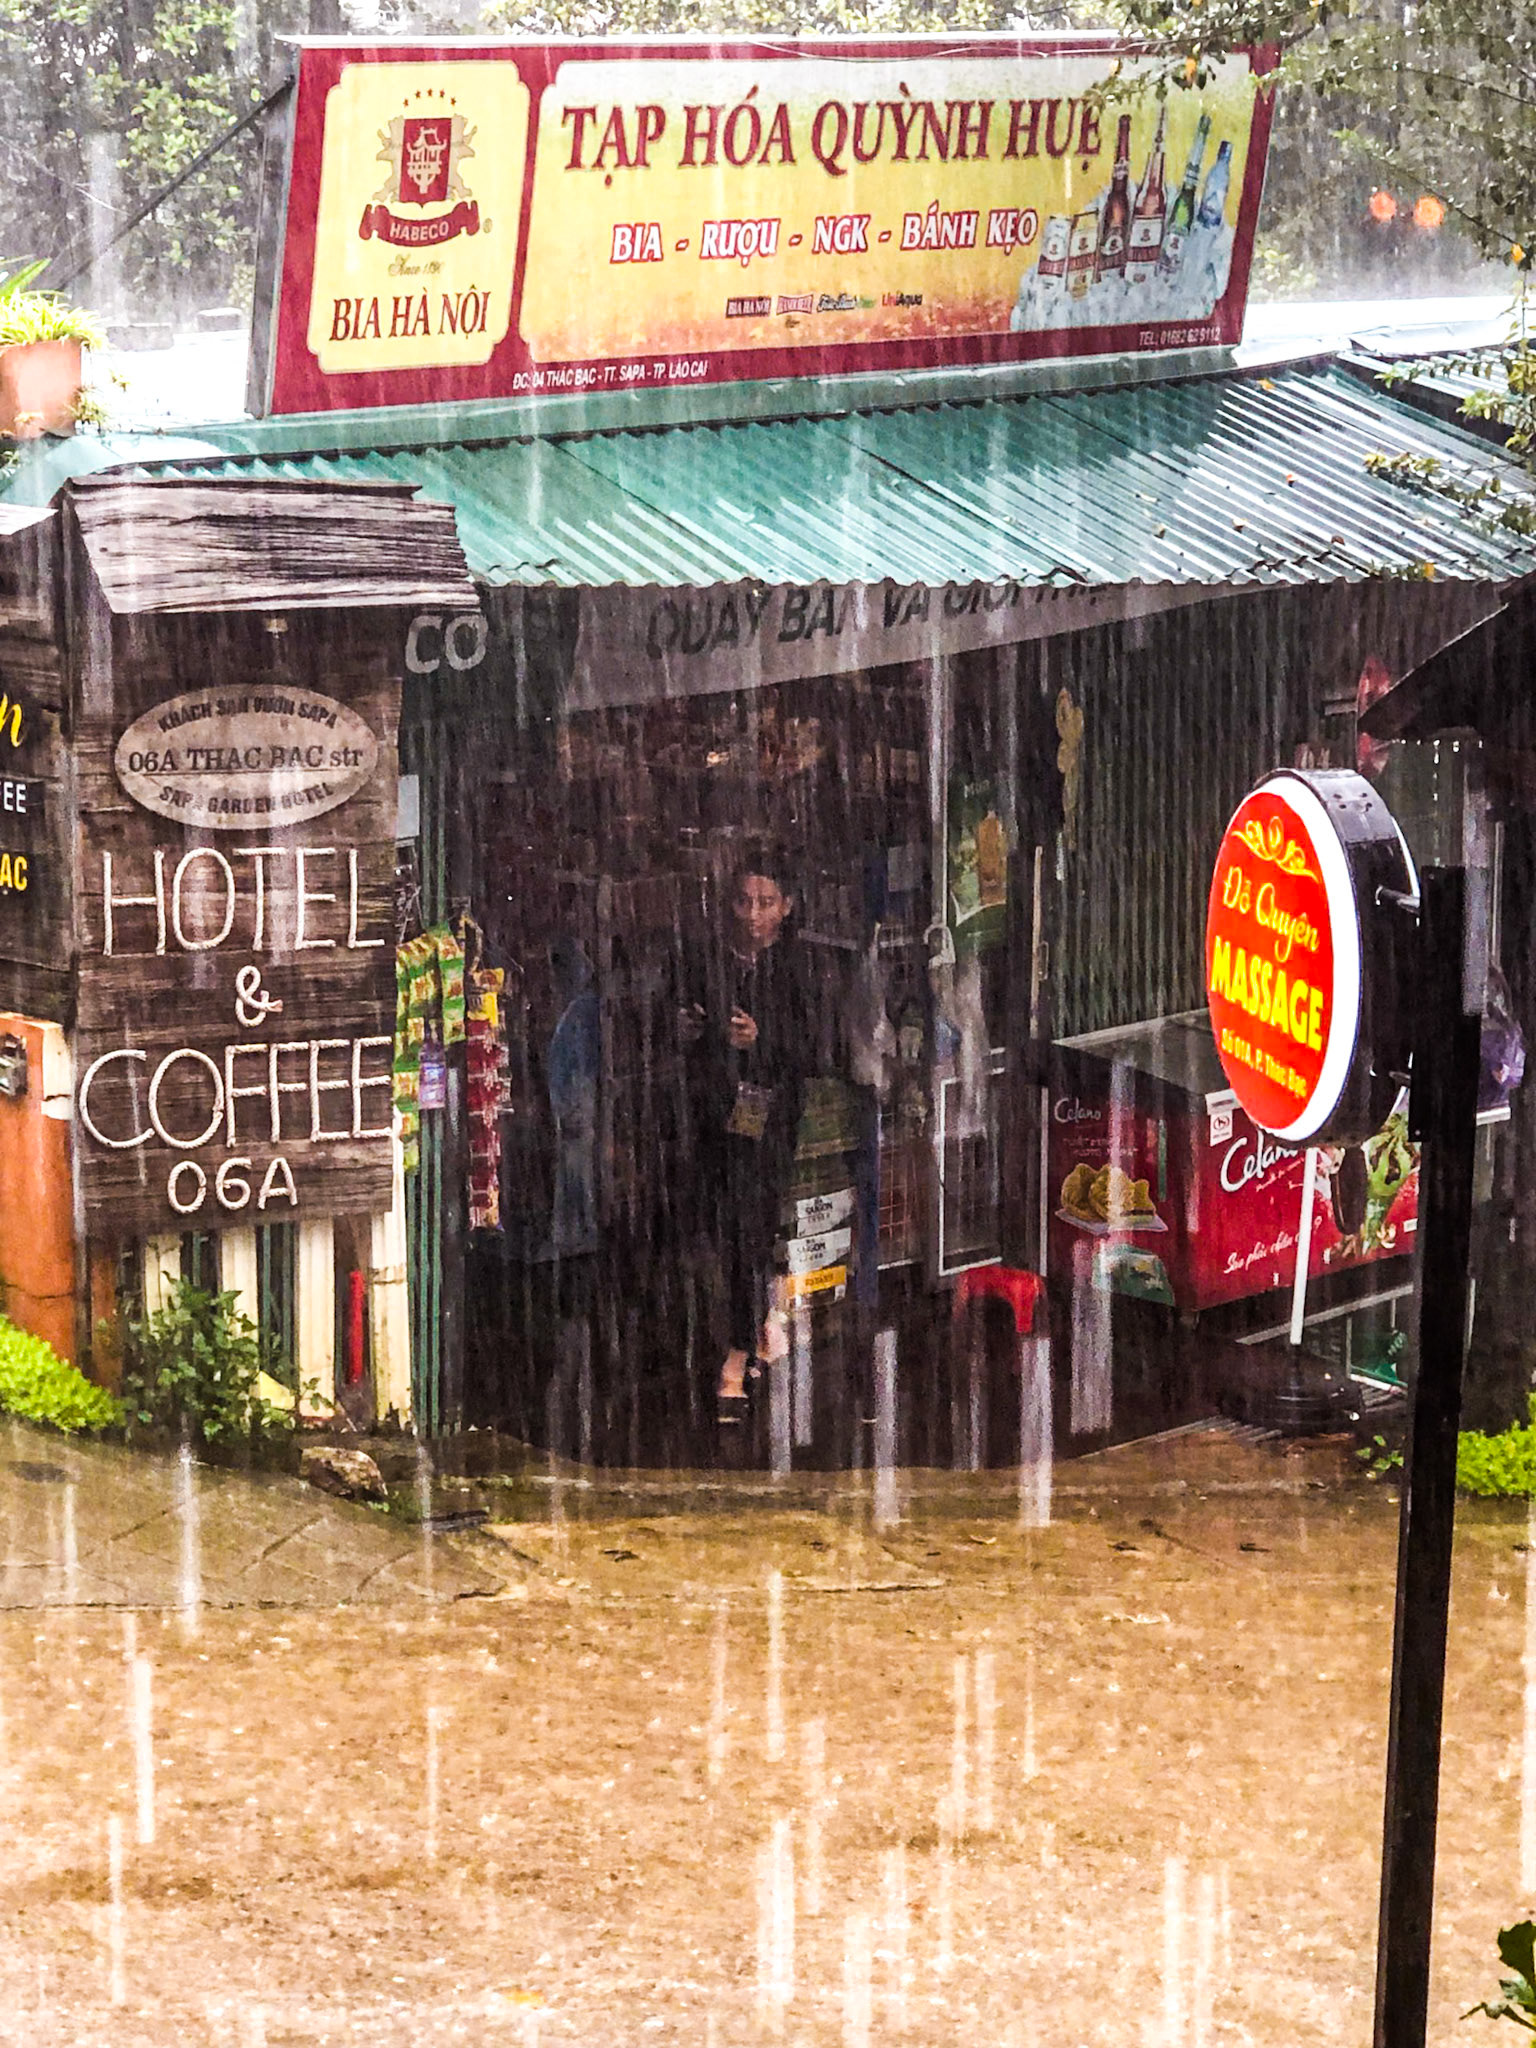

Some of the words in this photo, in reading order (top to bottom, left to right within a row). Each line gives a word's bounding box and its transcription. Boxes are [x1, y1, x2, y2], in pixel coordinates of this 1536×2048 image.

[562, 104, 667, 189] TẠP
[677, 85, 797, 167] HÓA
[811, 81, 994, 176] QUỲNH
[390, 221, 449, 241] HABECO
[609, 222, 663, 264] BIA
[700, 218, 781, 268] RƯỢU
[812, 214, 871, 254] NGK
[900, 199, 980, 250] BÁNH
[986, 208, 1038, 256] KẸO
[329, 297, 381, 341] BIA
[388, 287, 431, 337] HÀ
[438, 284, 492, 340] NỘI
[620, 364, 646, 382] SAPA
[691, 360, 708, 377] CAI
[405, 614, 489, 674] CO
[298, 706, 339, 730] SAPA
[128, 749, 178, 772] 06A
[187, 747, 262, 771] THAC
[269, 745, 323, 768] BAC
[329, 748, 364, 767] str
[103, 846, 386, 955] HOTEL
[1256, 882, 1319, 963] Quyên
[235, 964, 283, 1028] &
[1210, 935, 1324, 1051] MASSAGE
[79, 1035, 393, 1149] COFFEE
[1054, 1097, 1102, 1123] Celano
[167, 1156, 298, 1213] 06A
